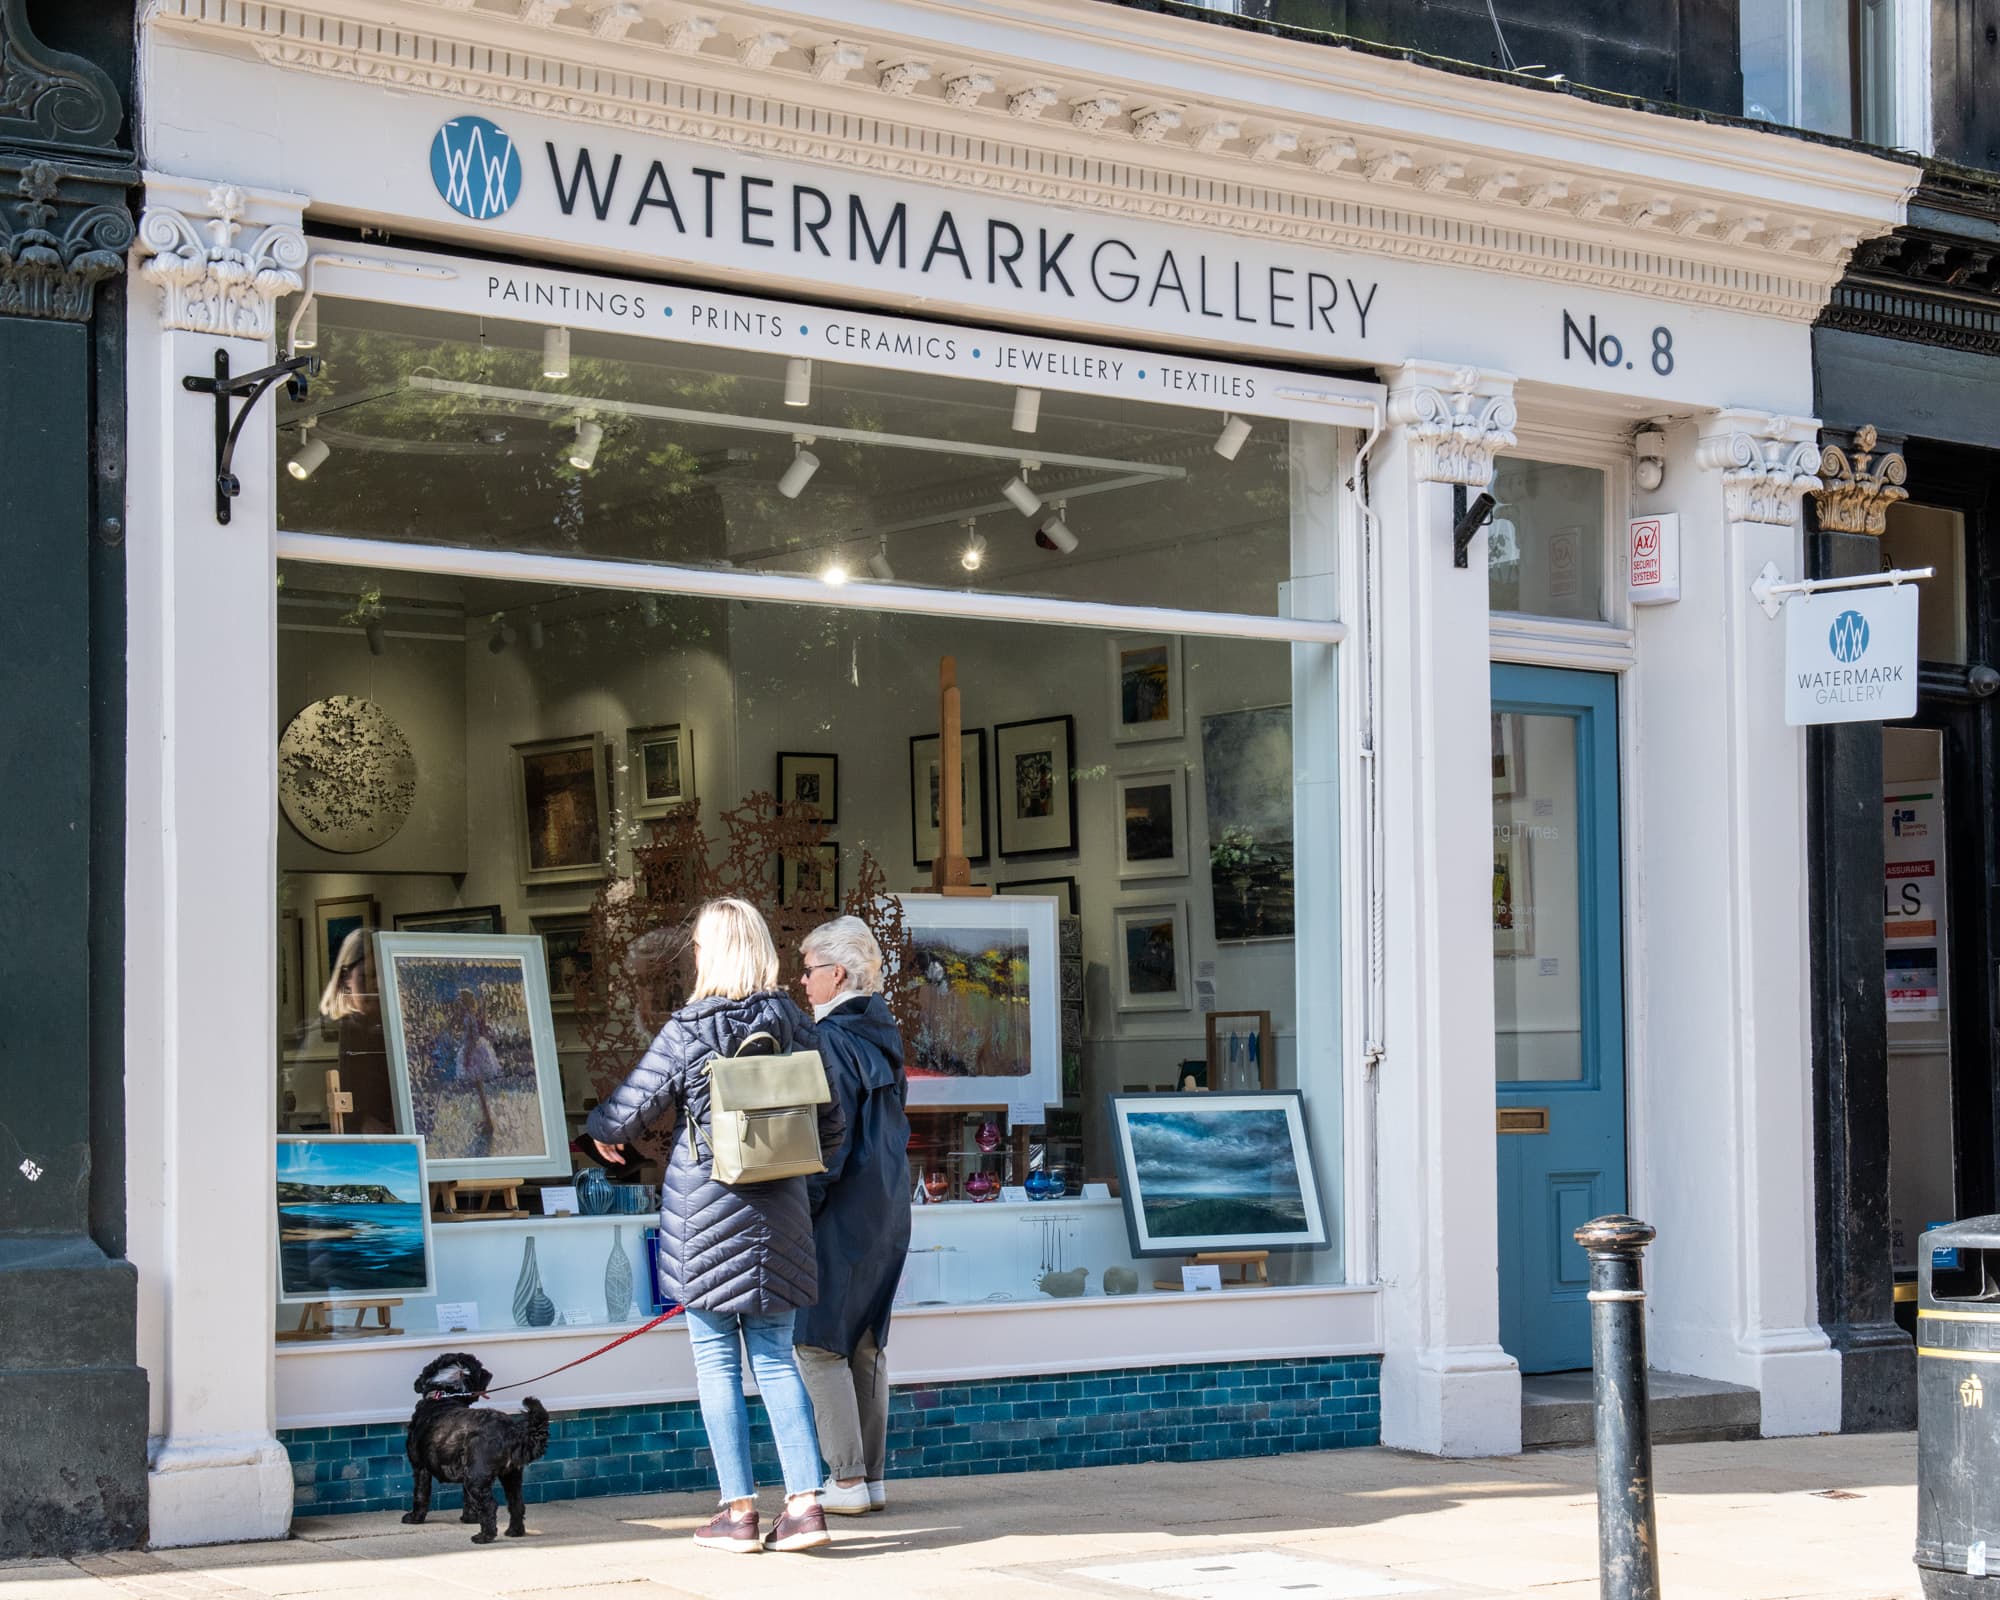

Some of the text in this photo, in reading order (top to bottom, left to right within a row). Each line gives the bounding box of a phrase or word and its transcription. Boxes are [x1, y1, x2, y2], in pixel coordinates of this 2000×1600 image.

[487, 276, 1256, 399] PAINTINGS PRINTS CERAMICS JEWELLERY TEXTILES
[1563, 308, 1675, 376] No. 8
[1633, 559, 1658, 570] SECURITY
[1633, 571, 1659, 582] SYSTEMS
[1798, 664, 1904, 689] WATERMARK
[1815, 685, 1885, 705] GALLERY
[1887, 864, 1931, 875] ASSURANCE
